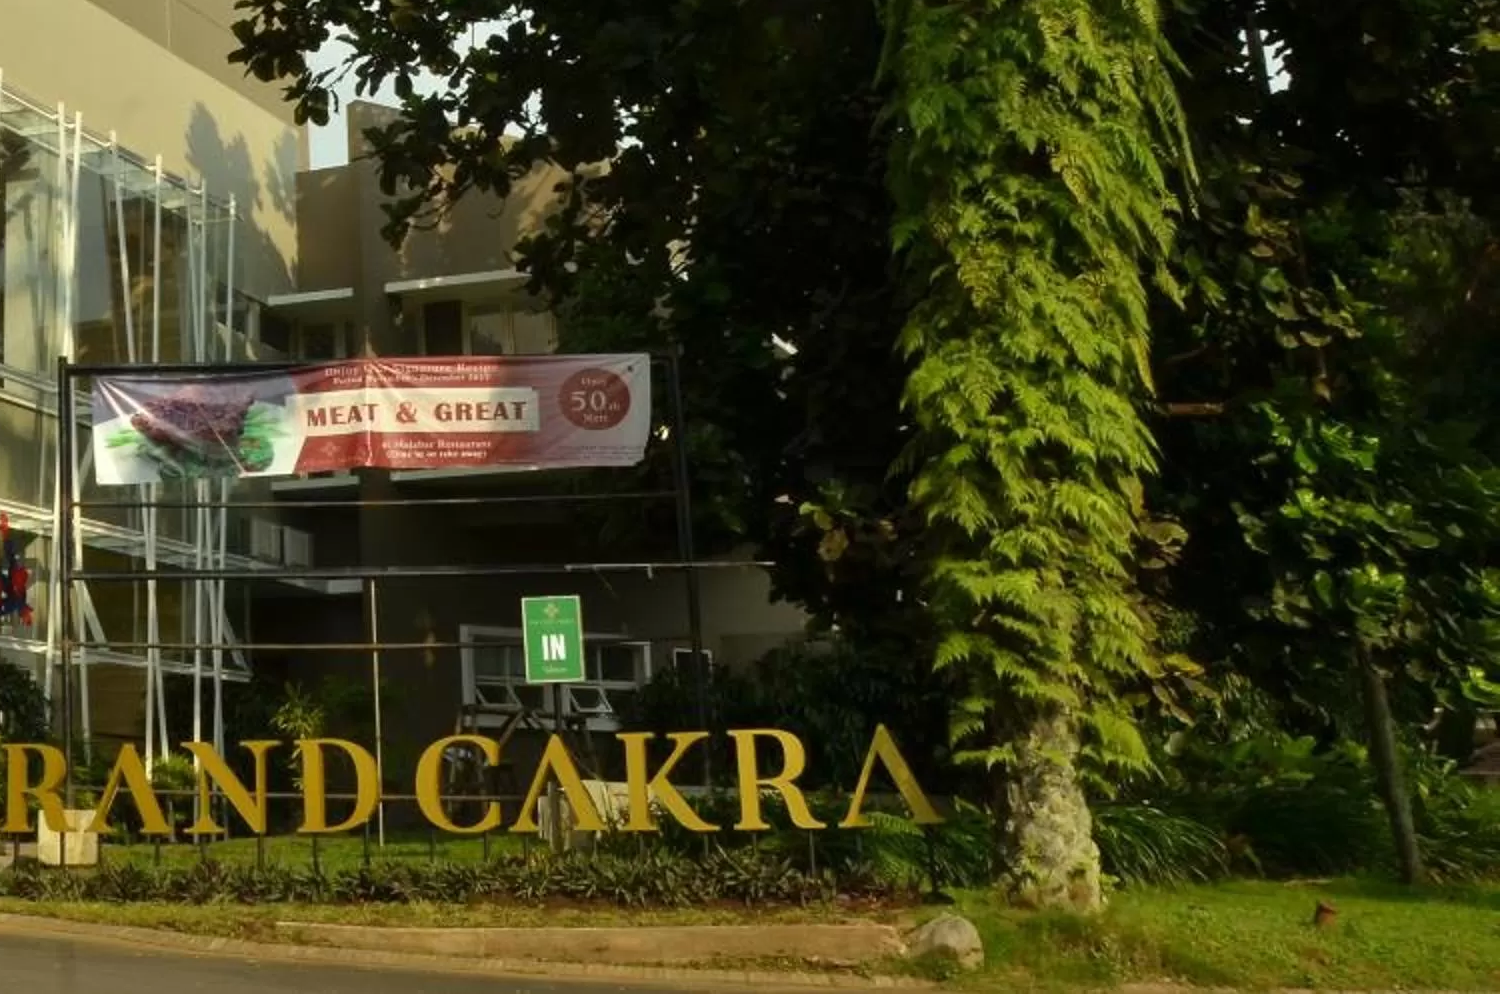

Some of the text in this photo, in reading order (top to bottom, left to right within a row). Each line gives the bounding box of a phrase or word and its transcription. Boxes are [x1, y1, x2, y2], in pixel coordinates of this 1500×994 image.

[307, 400, 527, 427] MEAT & GREAT
[541, 633, 567, 662] IN
[414, 723, 945, 835] CAKRA
